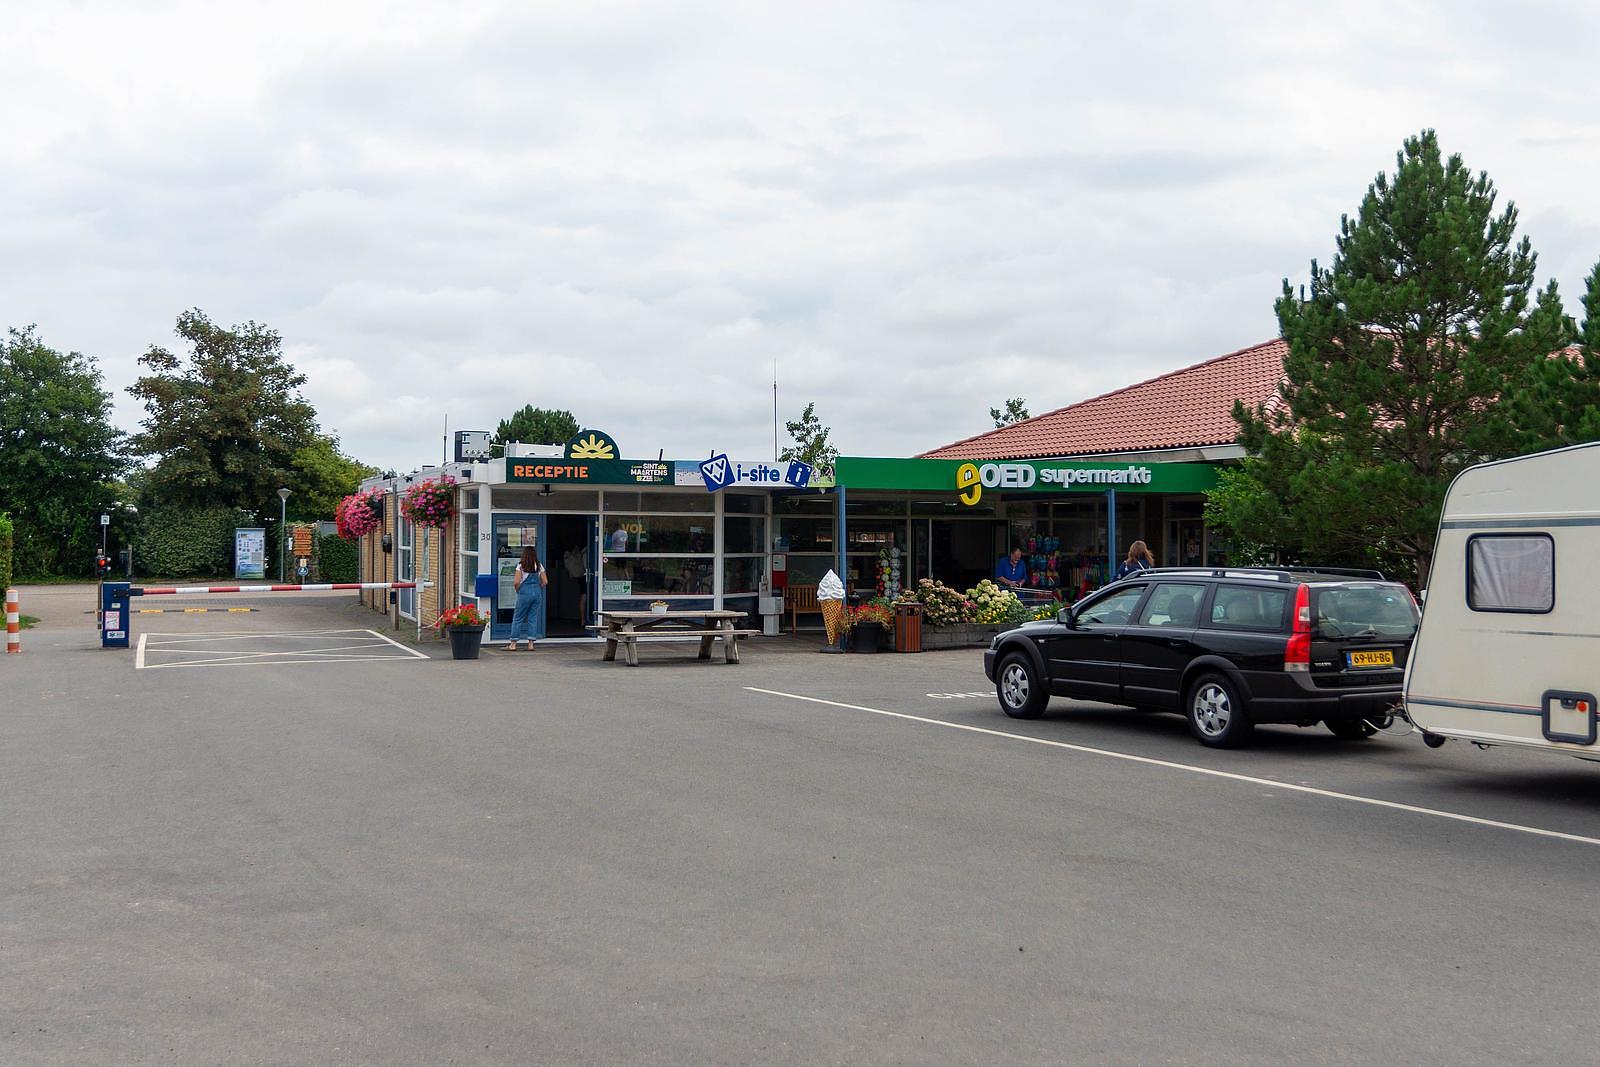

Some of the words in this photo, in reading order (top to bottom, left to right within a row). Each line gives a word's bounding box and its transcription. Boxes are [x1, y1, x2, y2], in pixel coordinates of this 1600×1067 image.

[513, 465, 589, 478] RECEPTIE
[737, 464, 780, 482] i-site
[1040, 466, 1151, 488] supermarkt
[481, 533, 491, 541] 30
[1353, 653, 1391, 664] 69-HJ-BG
